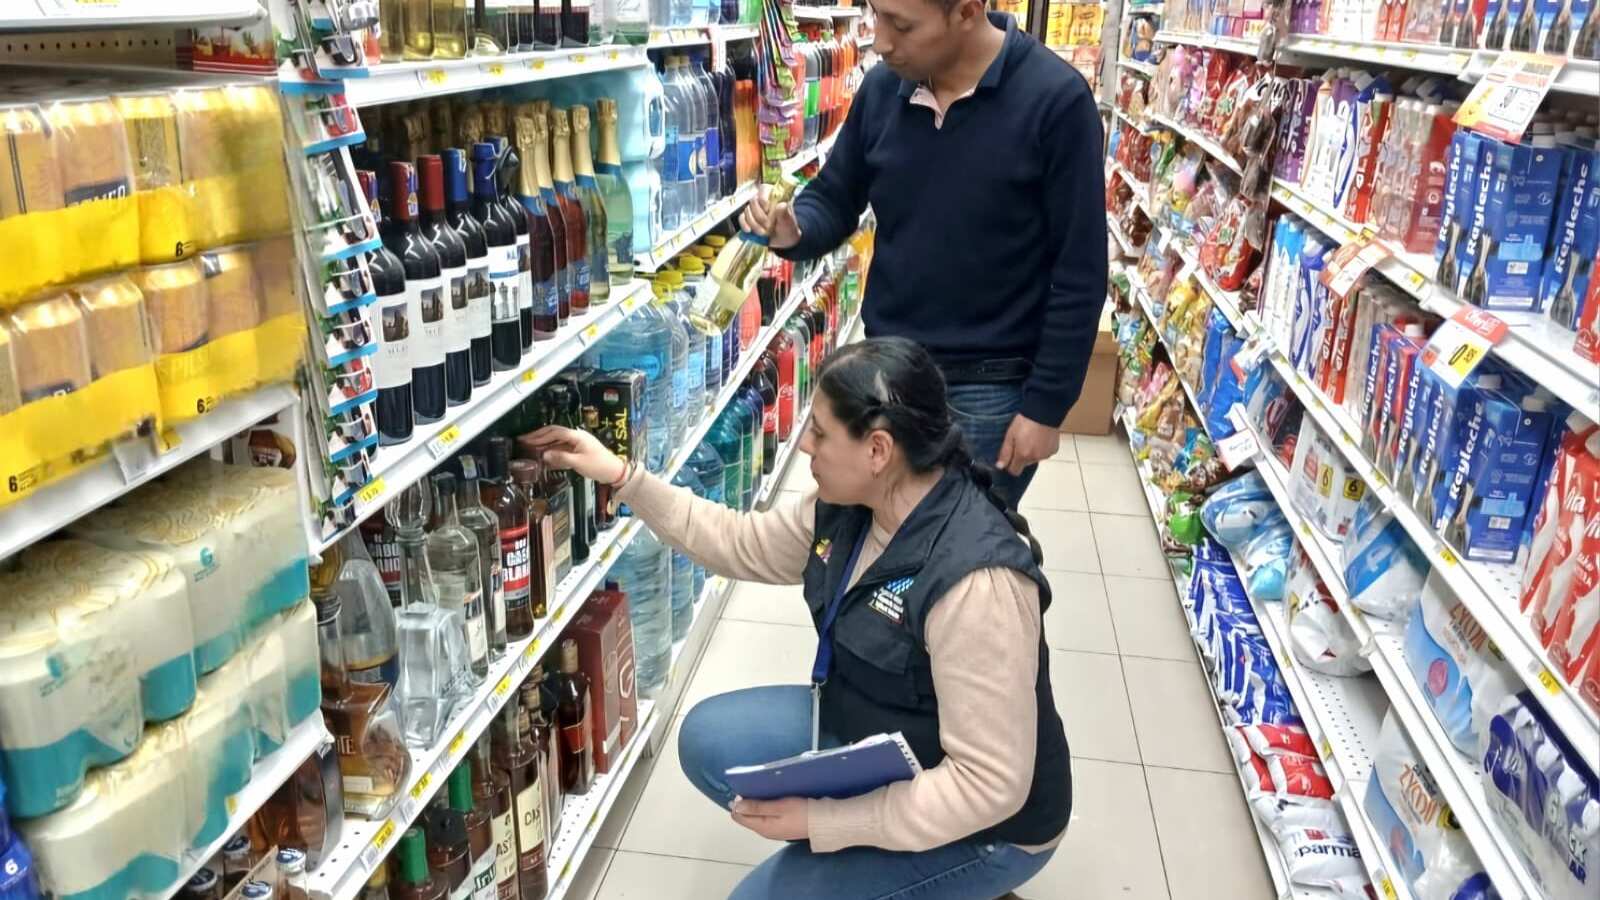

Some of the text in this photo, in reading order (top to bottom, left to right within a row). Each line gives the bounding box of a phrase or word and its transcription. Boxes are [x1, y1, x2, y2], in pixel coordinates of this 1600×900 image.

[1466, 151, 1492, 256] Reyleche
[175, 241, 184, 257] 6
[197, 398, 206, 414] 6
[615, 407, 628, 440] SAL
[1449, 401, 1483, 500] Reyleche
[9, 475, 18, 493] 6
[1322, 468, 1330, 487] 6
[1350, 480, 1358, 493] 6
[5, 858, 19, 876] 6
